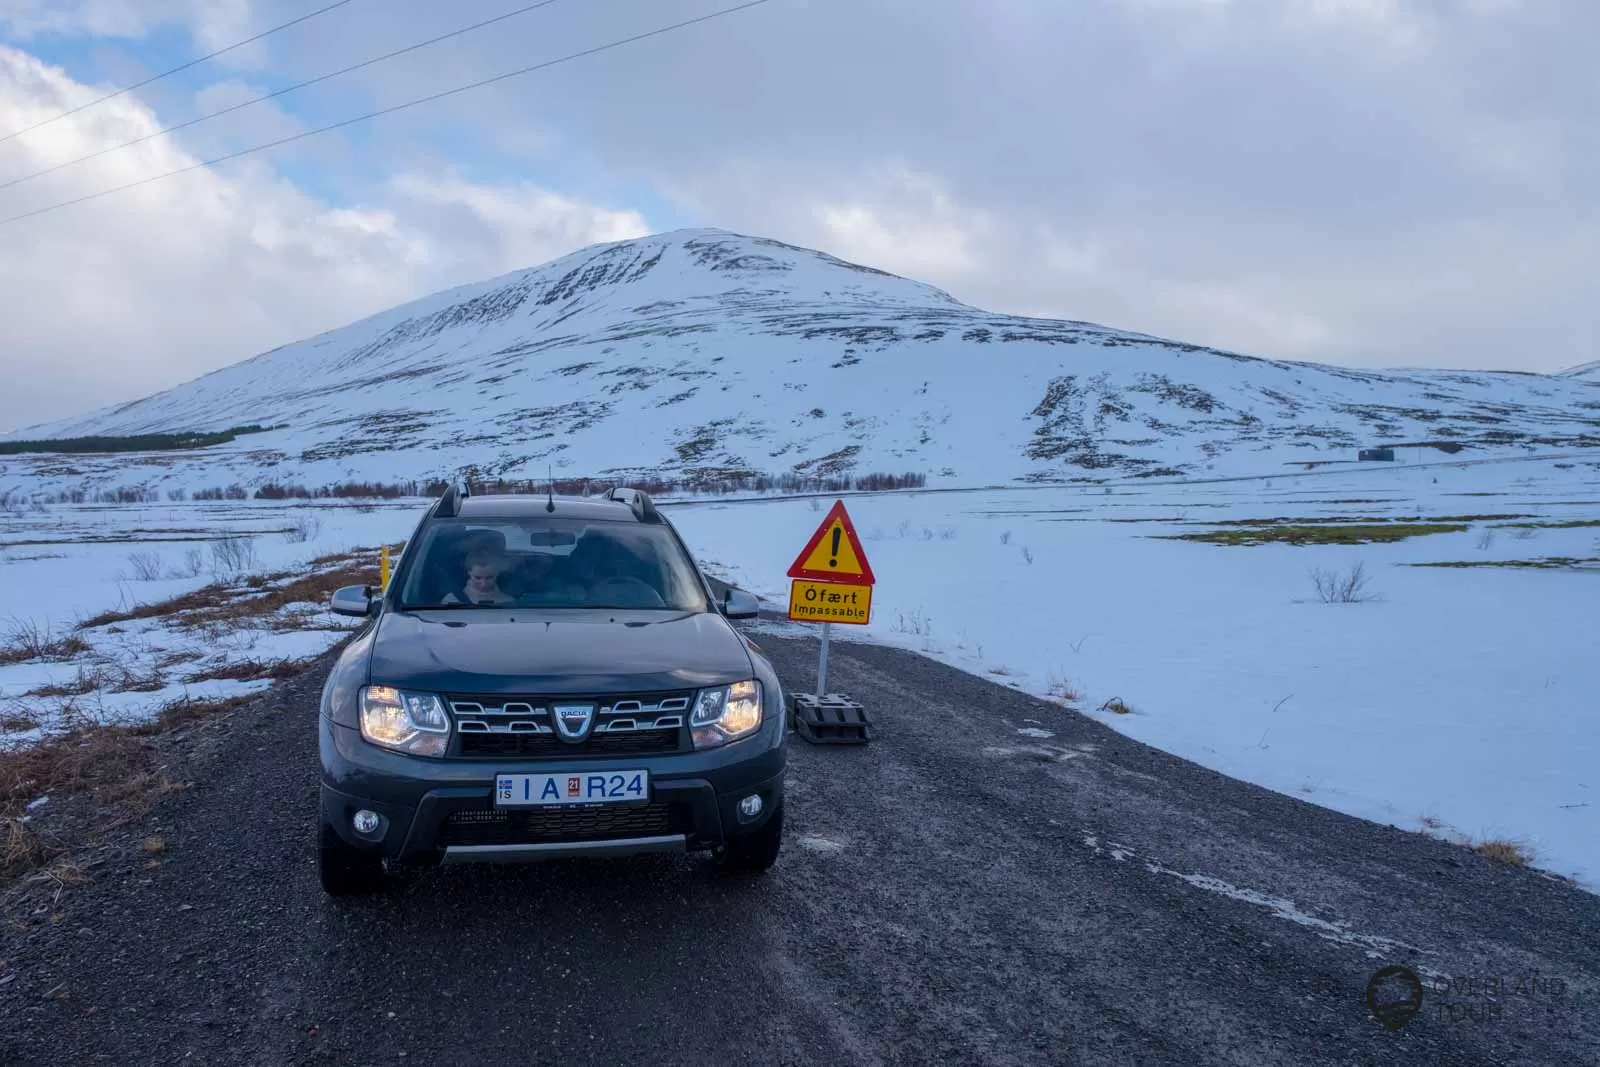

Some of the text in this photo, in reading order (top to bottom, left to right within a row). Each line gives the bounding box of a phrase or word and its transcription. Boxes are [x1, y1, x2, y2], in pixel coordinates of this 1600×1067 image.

[805, 584, 857, 605] Ófært
[794, 603, 865, 618] Impassable
[561, 710, 587, 718] DACIA
[569, 779, 580, 790] 21
[587, 774, 643, 799] R24
[499, 790, 512, 799] IS
